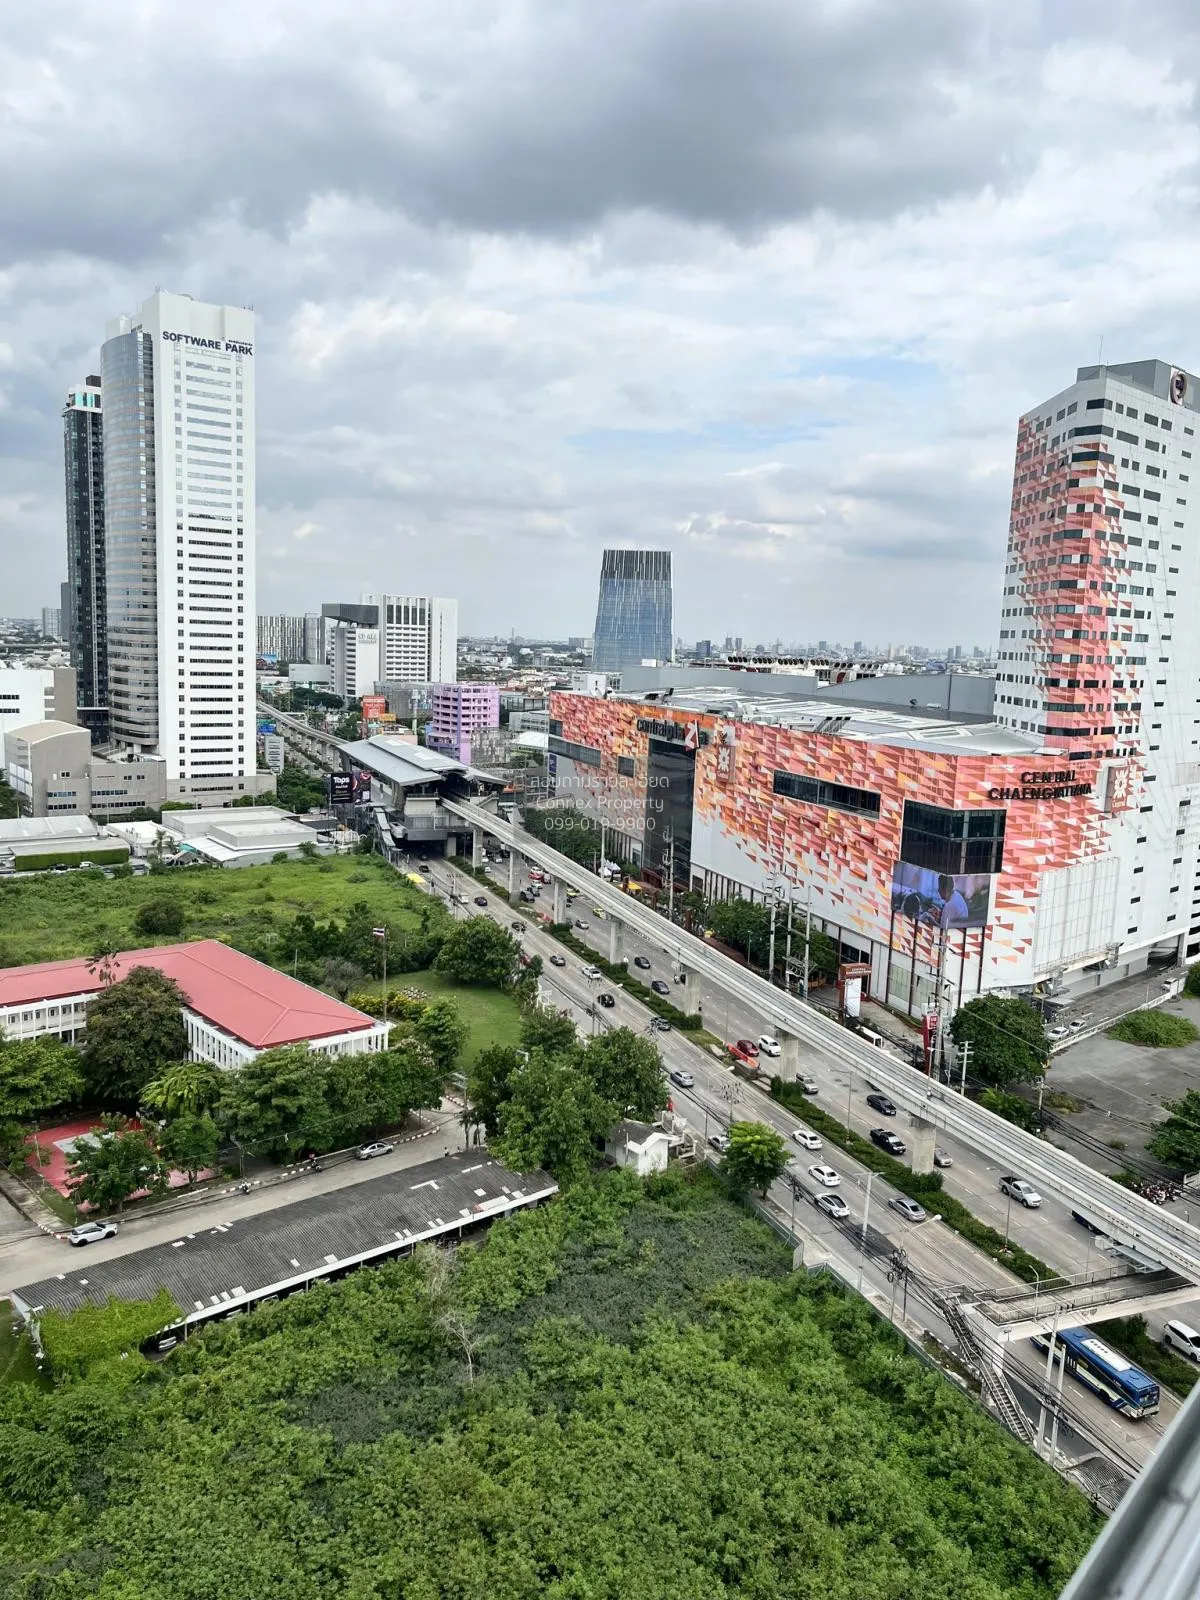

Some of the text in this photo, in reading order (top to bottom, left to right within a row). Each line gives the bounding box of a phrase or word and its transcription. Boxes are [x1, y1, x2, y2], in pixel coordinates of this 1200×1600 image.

[162, 331, 221, 350] SOFTWARE
[225, 343, 253, 356] PARK
[333, 776, 350, 785] Tops
[1021, 770, 1077, 783] CENTRAL
